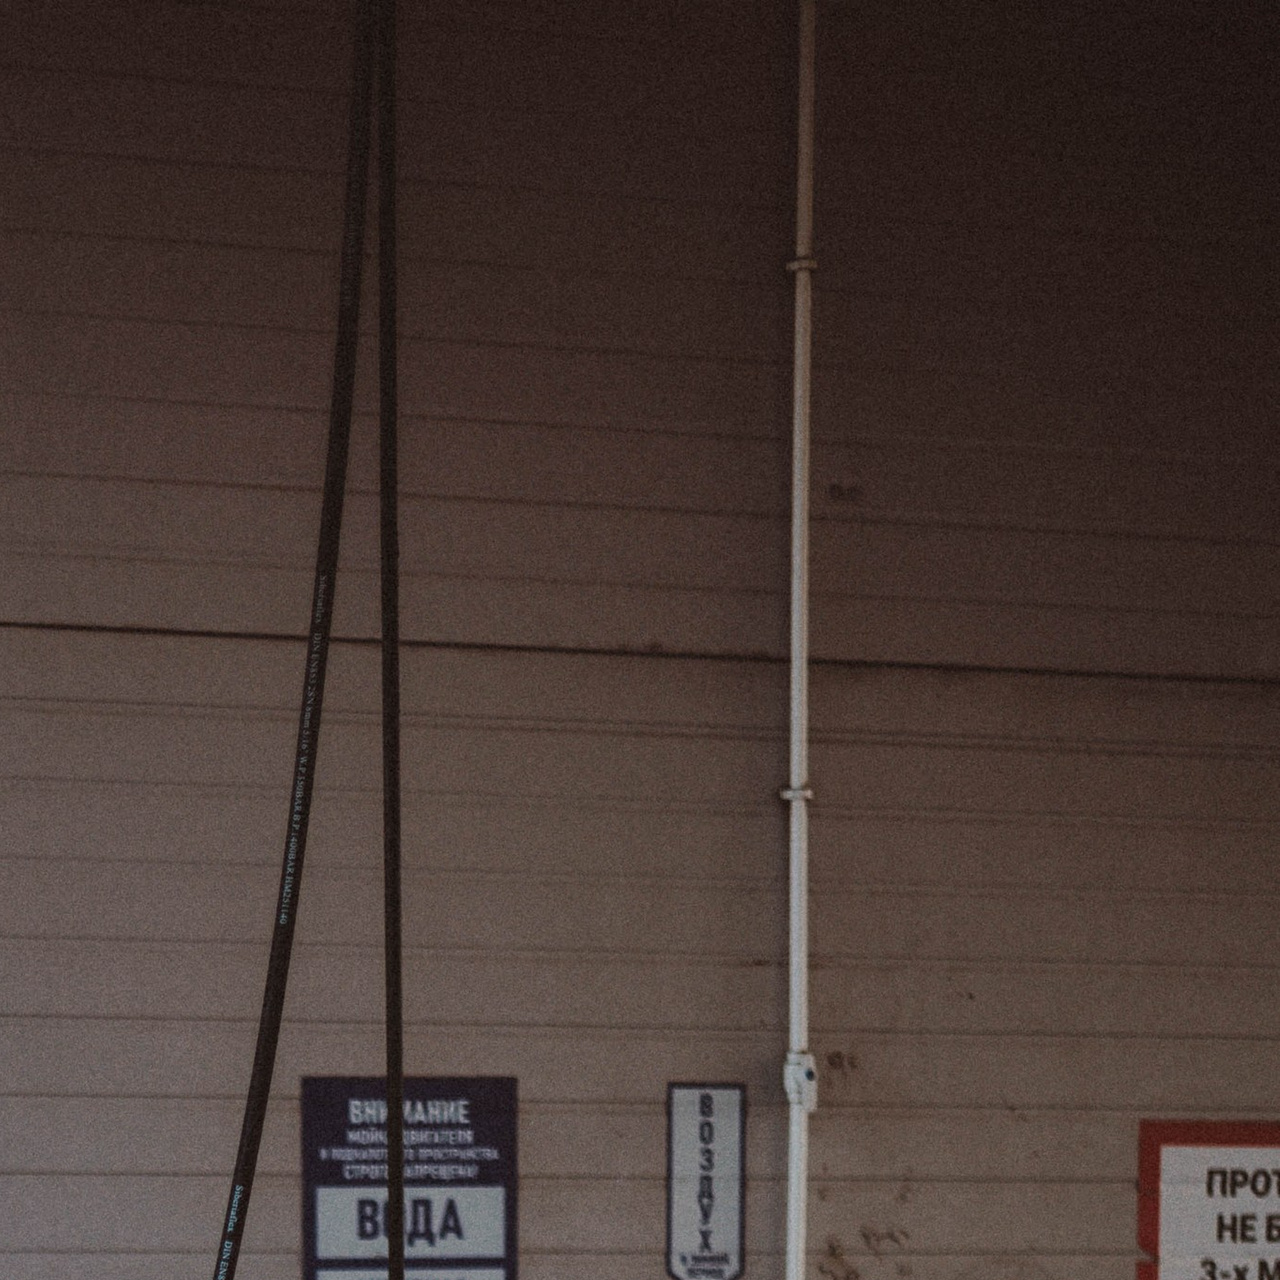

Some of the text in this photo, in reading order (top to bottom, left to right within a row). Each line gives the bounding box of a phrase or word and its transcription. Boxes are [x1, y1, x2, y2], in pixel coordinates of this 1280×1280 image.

[357, 1199, 464, 1246] ВДА
[1217, 1214, 1257, 1243] НЕ
[222, 1241, 233, 1260] DIN
